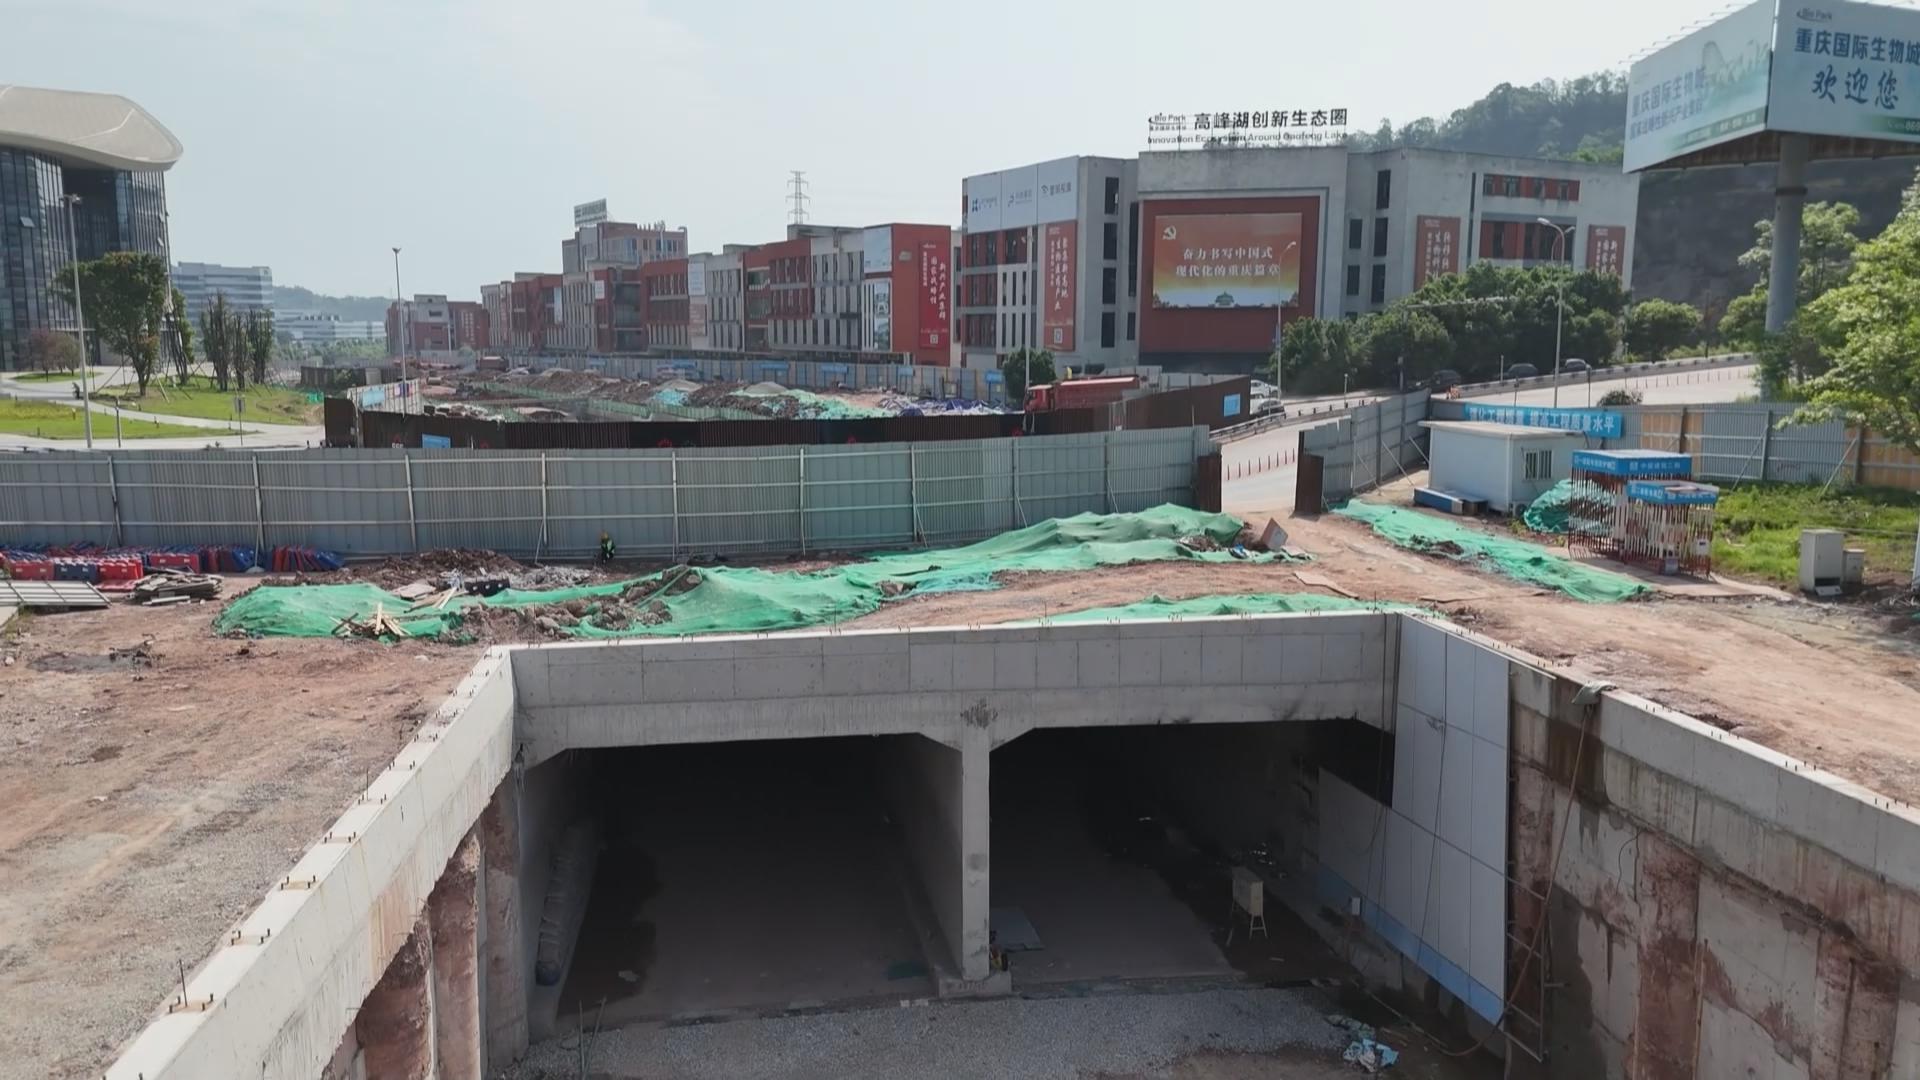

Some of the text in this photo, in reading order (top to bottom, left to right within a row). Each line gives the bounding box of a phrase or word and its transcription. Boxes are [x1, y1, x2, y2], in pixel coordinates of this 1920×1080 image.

[1794, 27, 1920, 66] 重庆国际生物城
[1812, 64, 1899, 110] 欢迎您
[1168, 114, 1186, 122] Park
[1194, 108, 1348, 131] 高峰湖创新生态圈
[1248, 132, 1280, 143] Around
[1325, 130, 1348, 141] Lake
[1183, 245, 1273, 261] 奋力书写中国式
[1175, 263, 1280, 278] 现代化的重庆篇章
